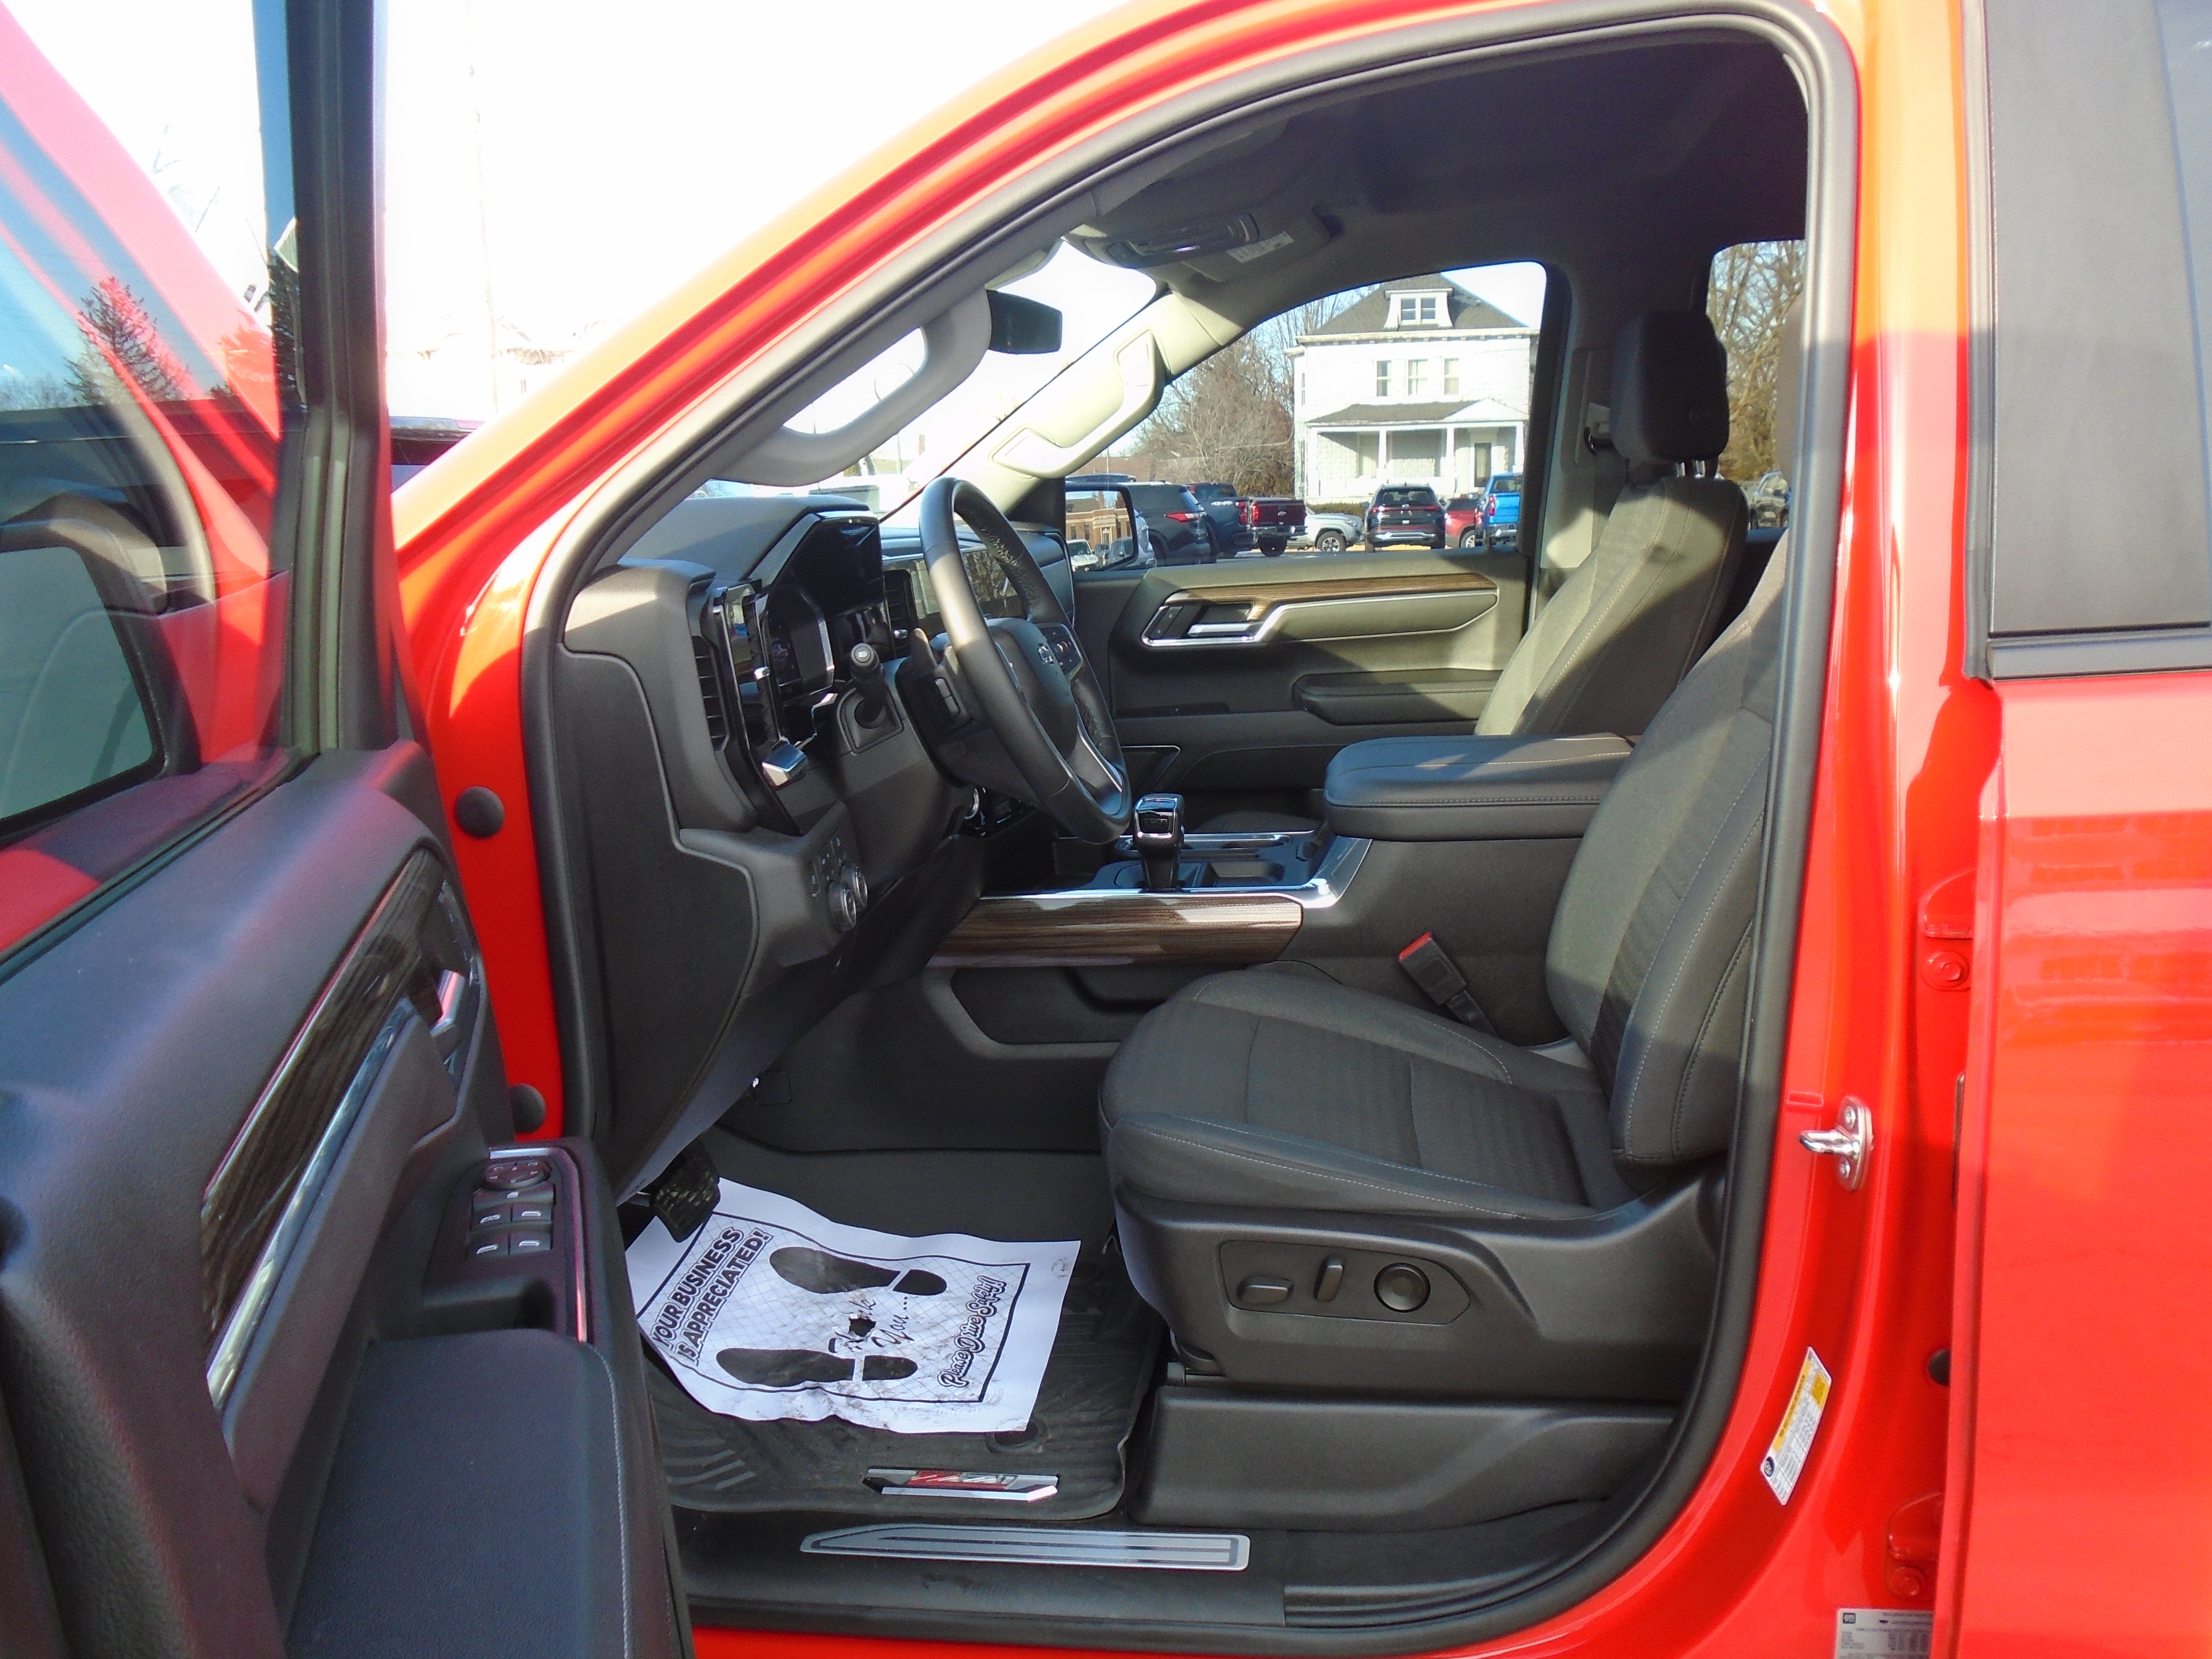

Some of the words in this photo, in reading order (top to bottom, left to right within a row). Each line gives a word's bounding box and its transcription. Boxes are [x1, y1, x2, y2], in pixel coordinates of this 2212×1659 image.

[651, 1303, 684, 1348] YOUR
[671, 1228, 741, 1307] BUSINESS
[682, 1229, 771, 1349] APPRECIATED!
[966, 1276, 1006, 1317] Safely!
[676, 1343, 698, 1364] IS
[954, 1316, 985, 1352] Drive
[938, 1350, 973, 1387] Please
